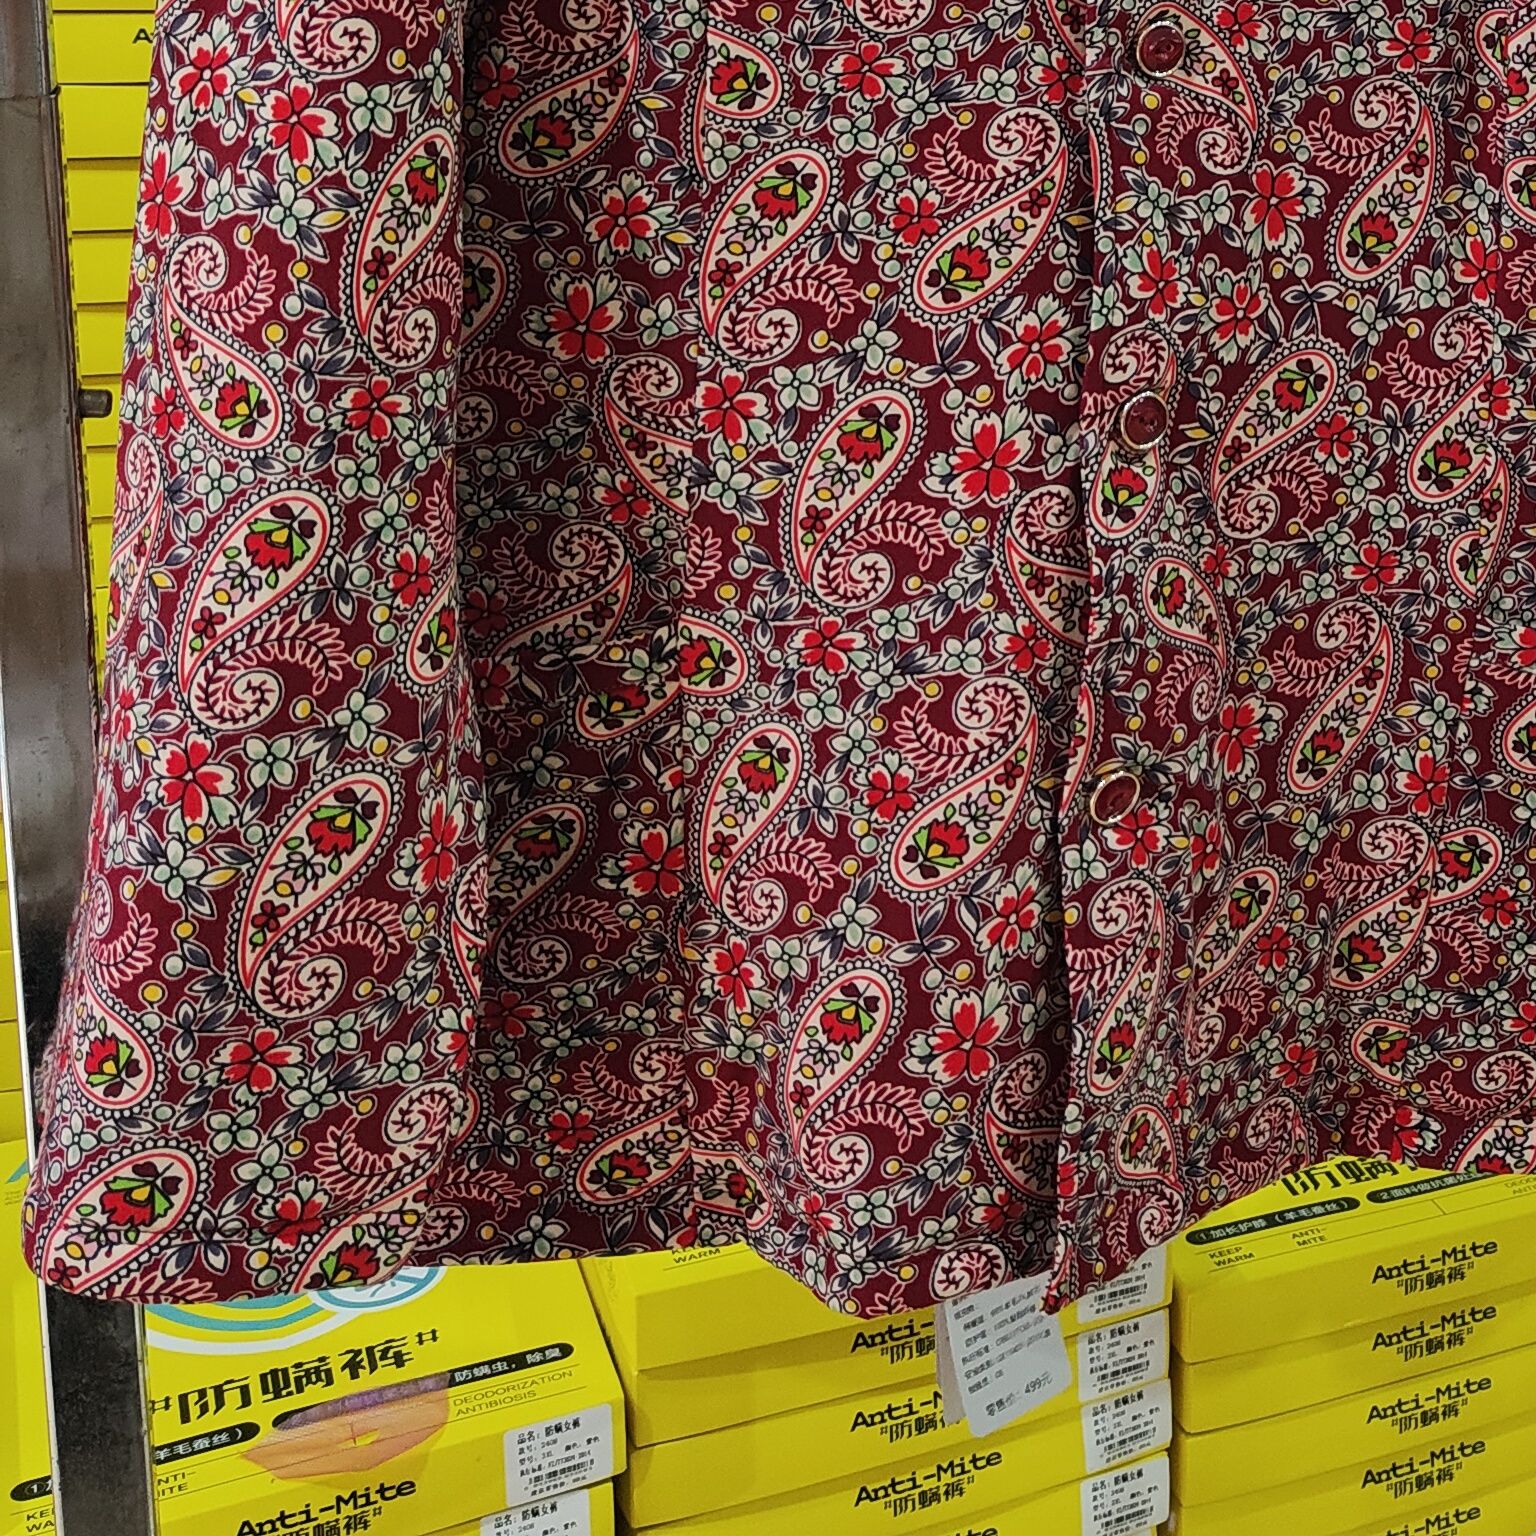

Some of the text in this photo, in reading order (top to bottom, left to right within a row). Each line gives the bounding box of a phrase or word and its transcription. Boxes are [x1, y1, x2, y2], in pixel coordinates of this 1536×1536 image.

[1208, 1246, 1243, 1260] KEEP
[1213, 1252, 1256, 1267] WARM
[1372, 1241, 1498, 1284] Anti-Mite
[1371, 1306, 1497, 1351] Anti-Mite
[453, 1369, 573, 1407] DEODORIZATION
[456, 1389, 537, 1417] ANTIBIOSIS
[1366, 1377, 1492, 1424] Anti-Mite
[854, 1451, 1003, 1507] Anti-Mite
[1361, 1440, 1486, 1489] Anti-Mite
[235, 1479, 417, 1536] Anti-Mite
